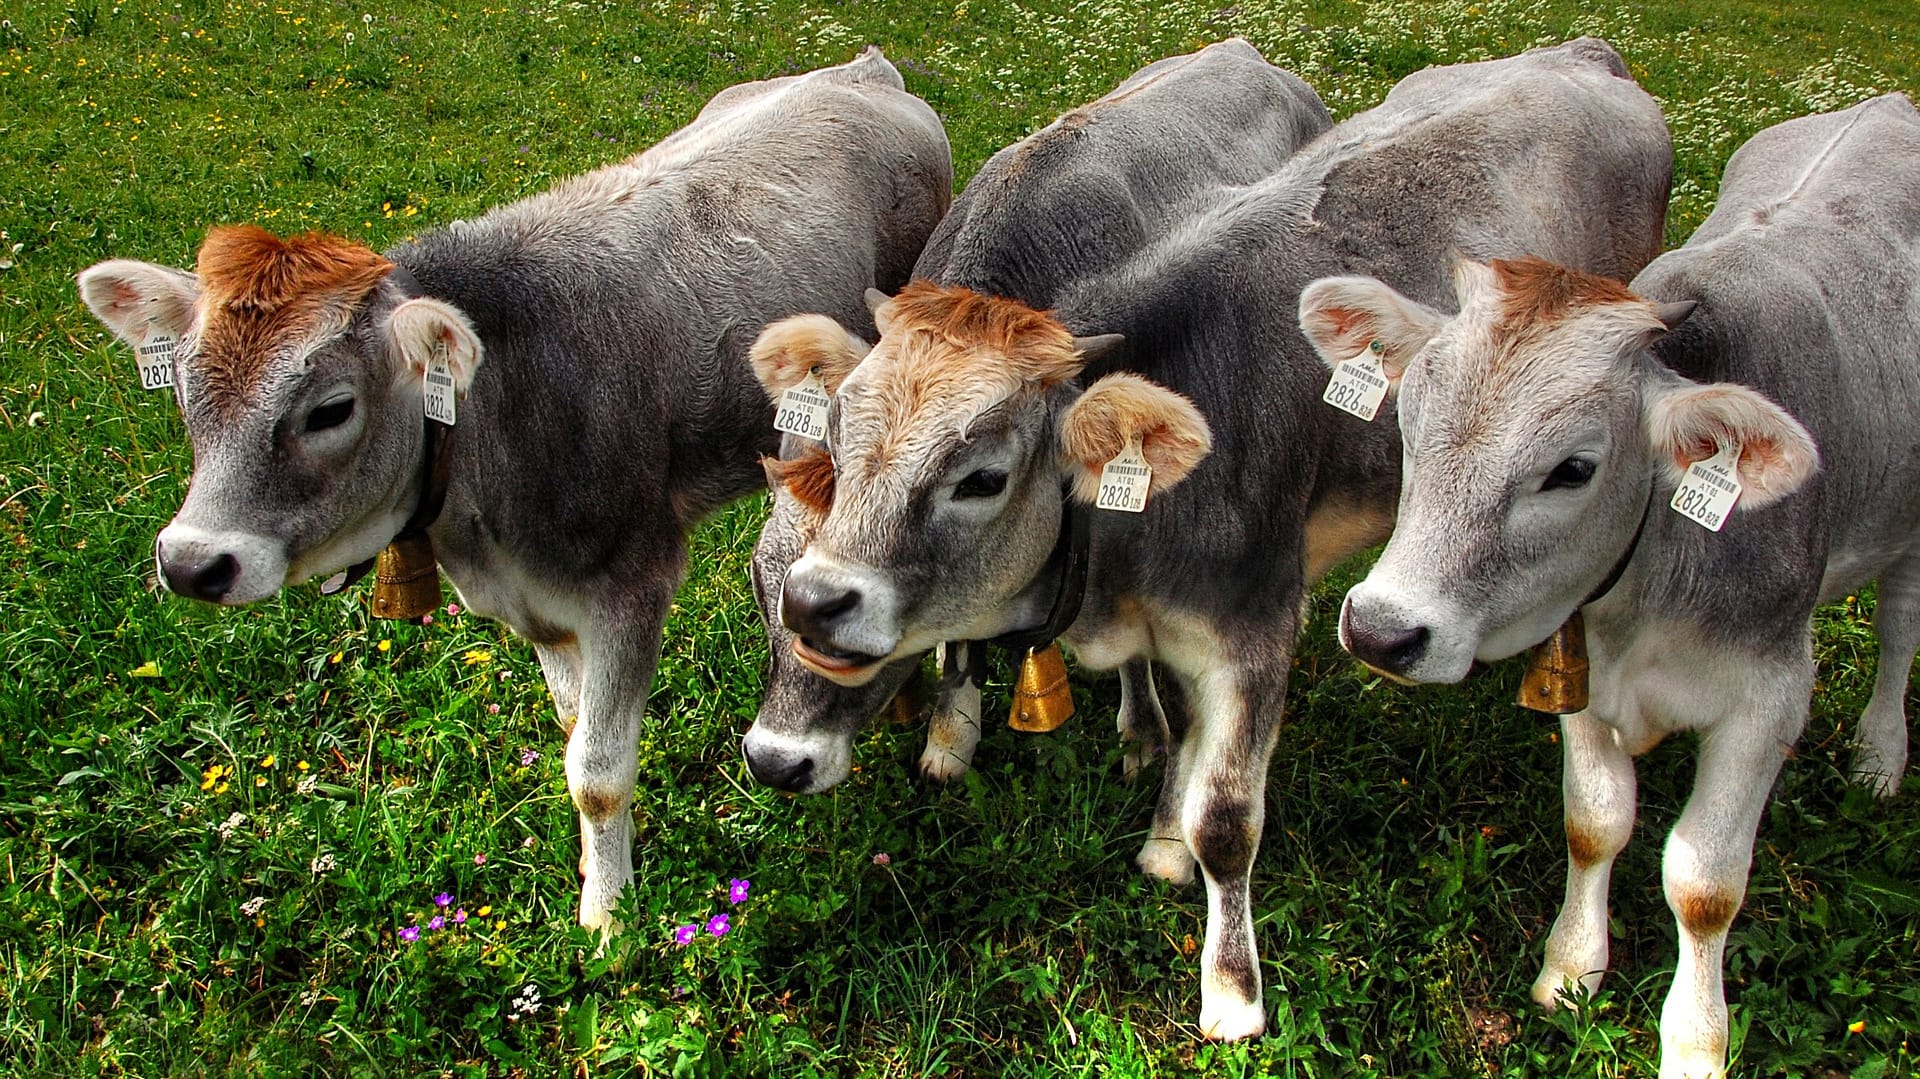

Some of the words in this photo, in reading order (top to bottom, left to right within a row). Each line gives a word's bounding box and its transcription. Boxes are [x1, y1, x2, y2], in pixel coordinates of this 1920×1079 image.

[155, 354, 173, 362] AT0
[143, 364, 173, 387] 282
[426, 394, 444, 418] 2822
[1327, 381, 1362, 411] 2826
[777, 408, 811, 433] 2828
[810, 425, 823, 437] 128
[1100, 485, 1131, 507] 2828
[1674, 485, 1712, 519] 2826
